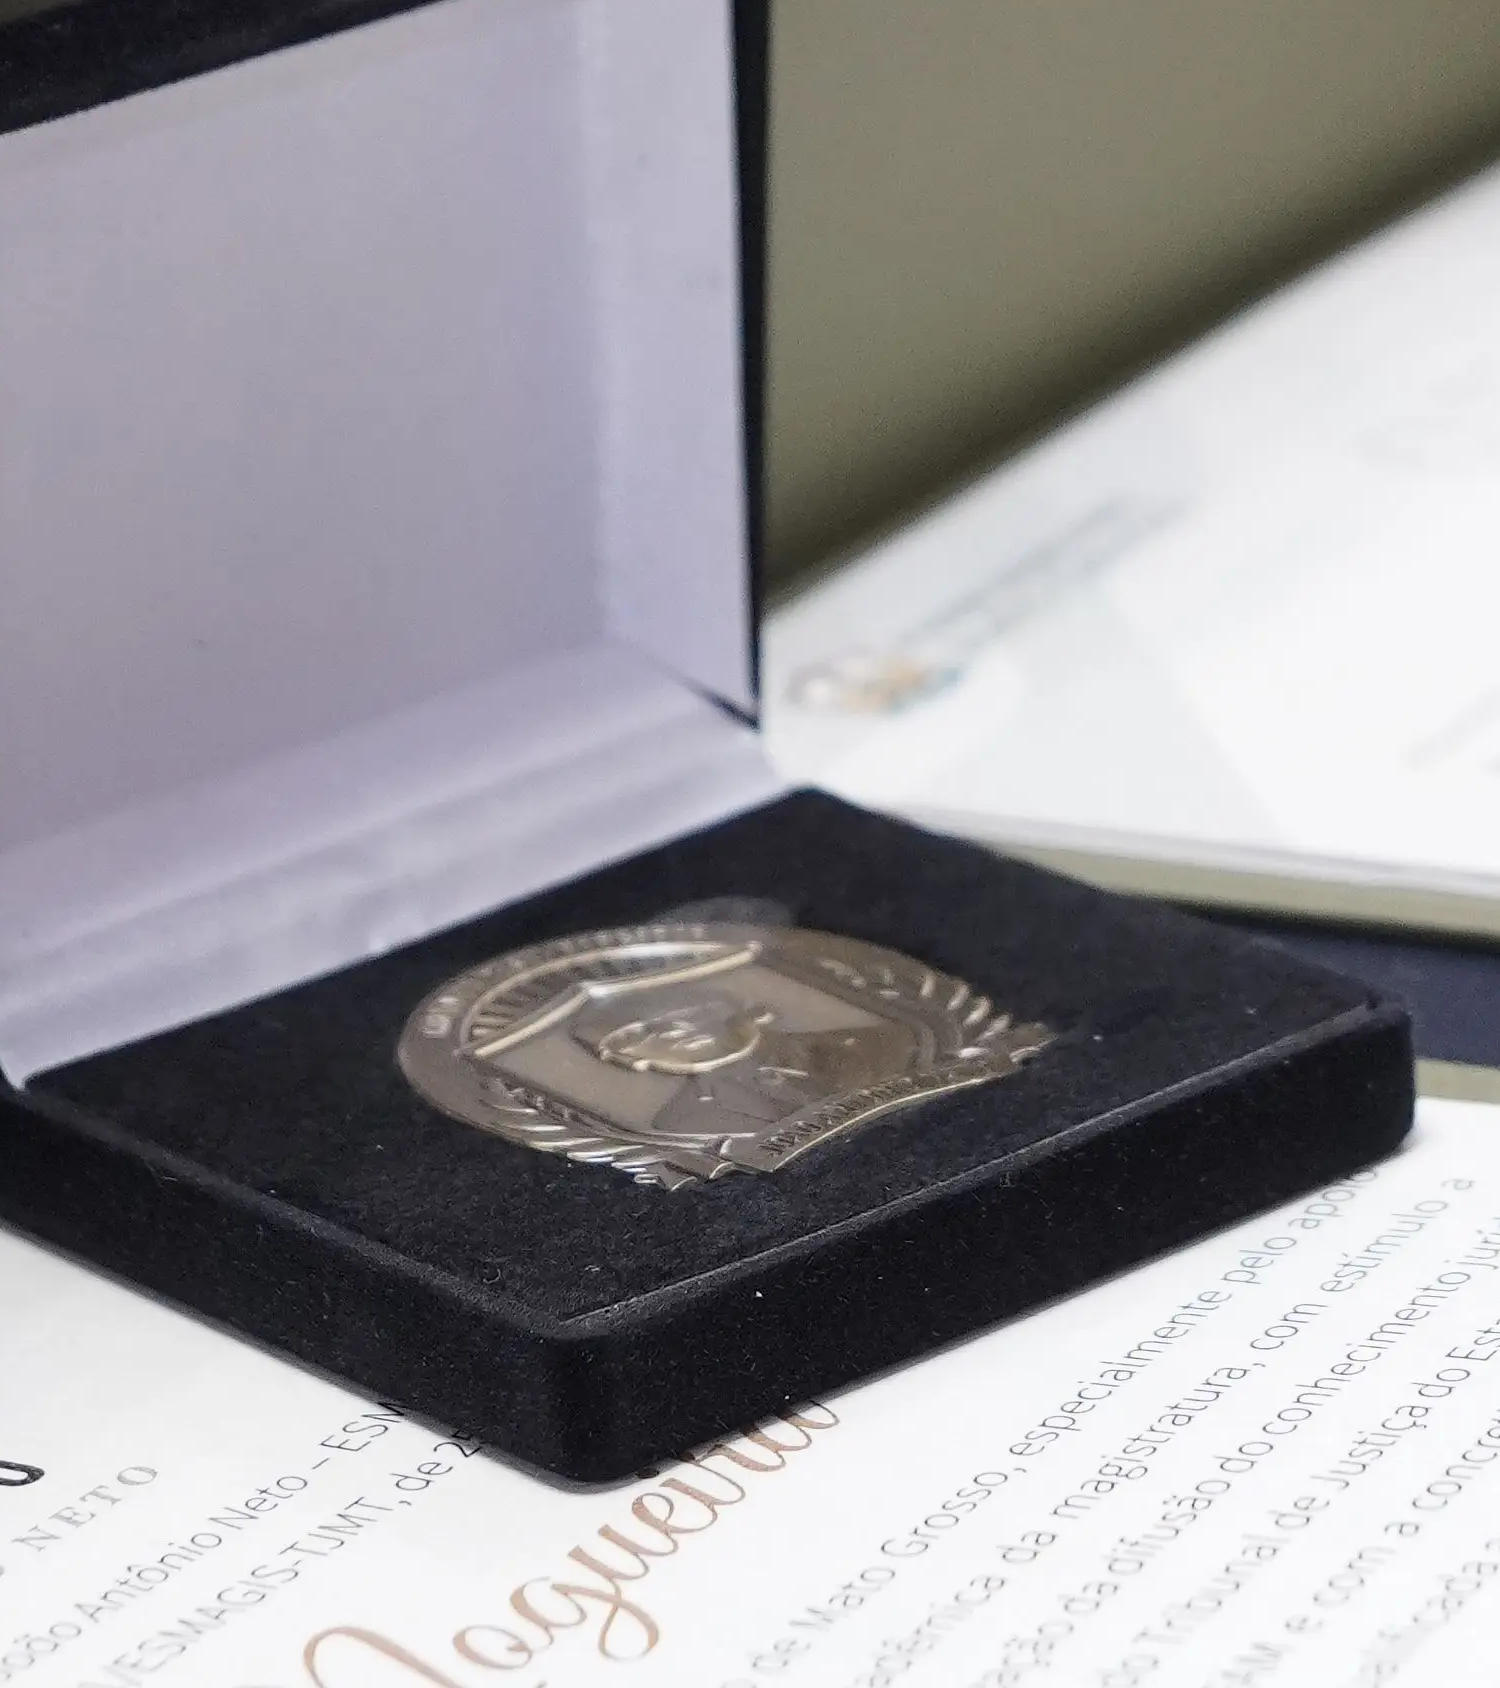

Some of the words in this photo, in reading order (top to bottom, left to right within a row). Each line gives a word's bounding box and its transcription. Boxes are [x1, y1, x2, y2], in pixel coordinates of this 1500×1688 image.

[389, 1461, 454, 1491] de
[747, 1637, 812, 1673] de
[787, 1565, 897, 1631] Mato
[880, 1467, 1027, 1558] Grosso,
[1009, 1288, 1232, 1457] especialmente
[1221, 1234, 1298, 1286] pelo
[996, 1529, 1059, 1565] da
[1049, 1361, 1267, 1519] magistratura,
[1249, 1300, 1328, 1352] com
[1319, 1199, 1449, 1294] estímulo
[1440, 1177, 1475, 1192] a
[1057, 1580, 1121, 1616] da
[1100, 1477, 1231, 1575] difusão
[1213, 1440, 1274, 1474] do
[1262, 1270, 1471, 1435] conhecimento
[11, 1465, 159, 1552] NETO
[74, 1529, 223, 1623] Antônio
[208, 1474, 309, 1530] Neto
[1130, 1532, 1292, 1645] Tribunal
[1266, 1494, 1331, 1531] de
[1309, 1404, 1430, 1491] Justiça
[1417, 1366, 1471, 1398] do
[1284, 1614, 1324, 1634] e
[1312, 1546, 1397, 1608] com
[1383, 1520, 1422, 1538] a
